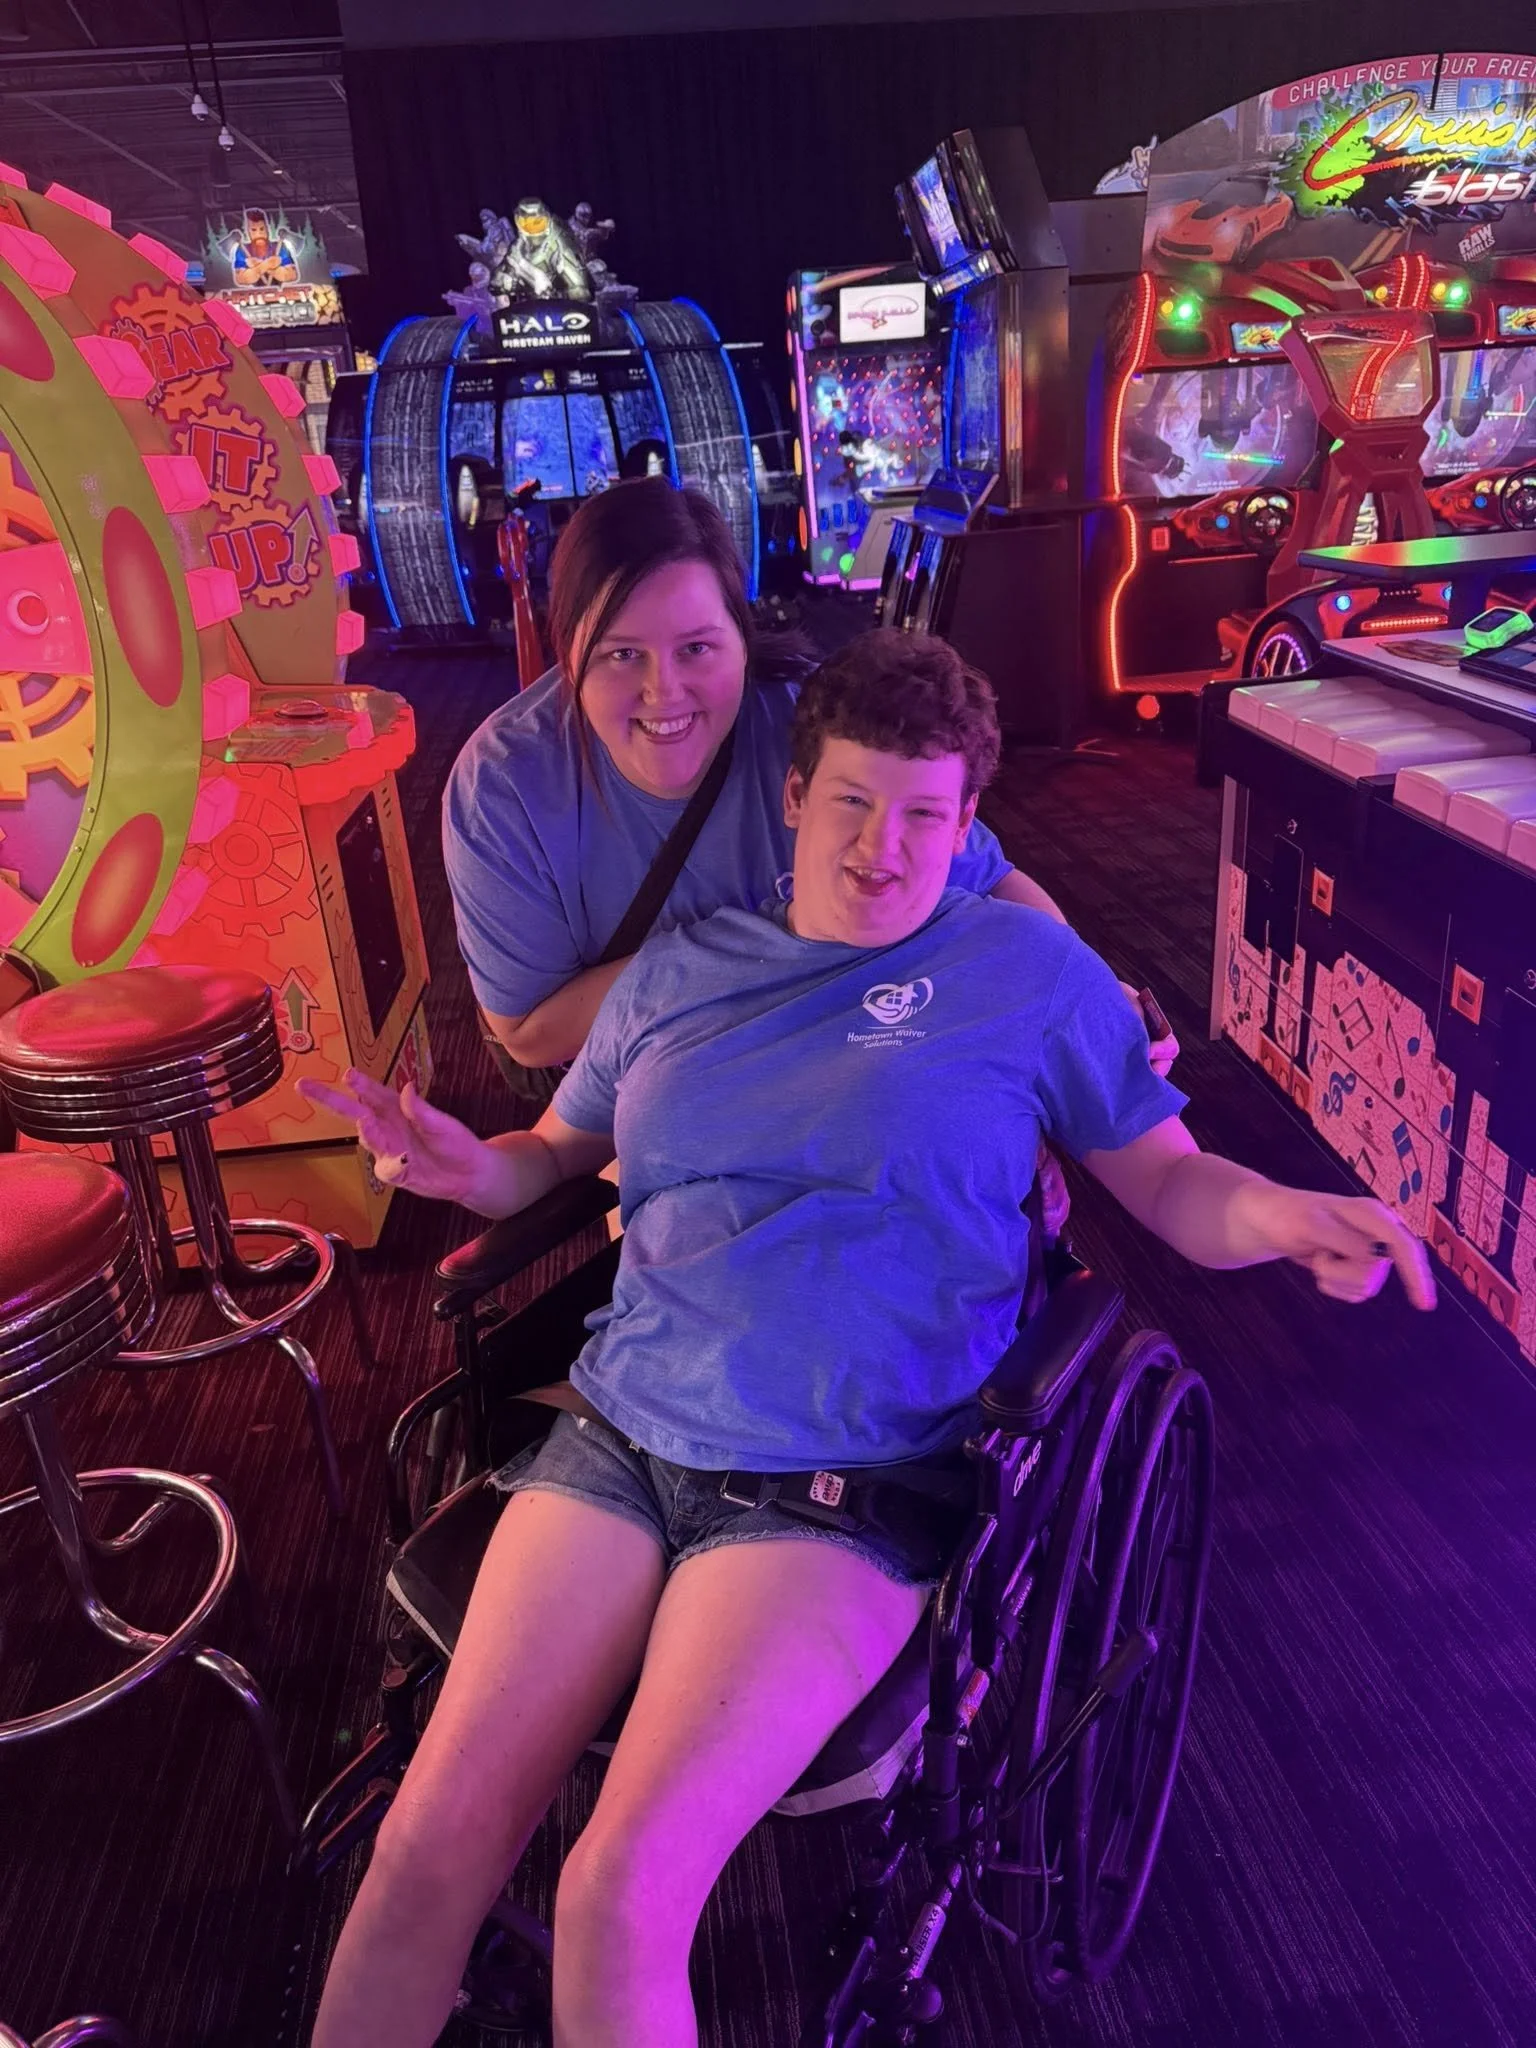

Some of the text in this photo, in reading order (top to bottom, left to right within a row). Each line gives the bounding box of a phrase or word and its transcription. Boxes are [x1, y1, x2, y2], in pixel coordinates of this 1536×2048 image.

[1289, 57, 1536, 103] CHALLENGE YOUR FRIE
[1458, 223, 1492, 255] RAW
[499, 312, 591, 335] HALO
[502, 334, 591, 348] FIRETEAM RAVEN
[190, 426, 262, 495] IT
[847, 1028, 927, 1042] Hometown Waiver
[863, 1039, 903, 1049] Solutions
